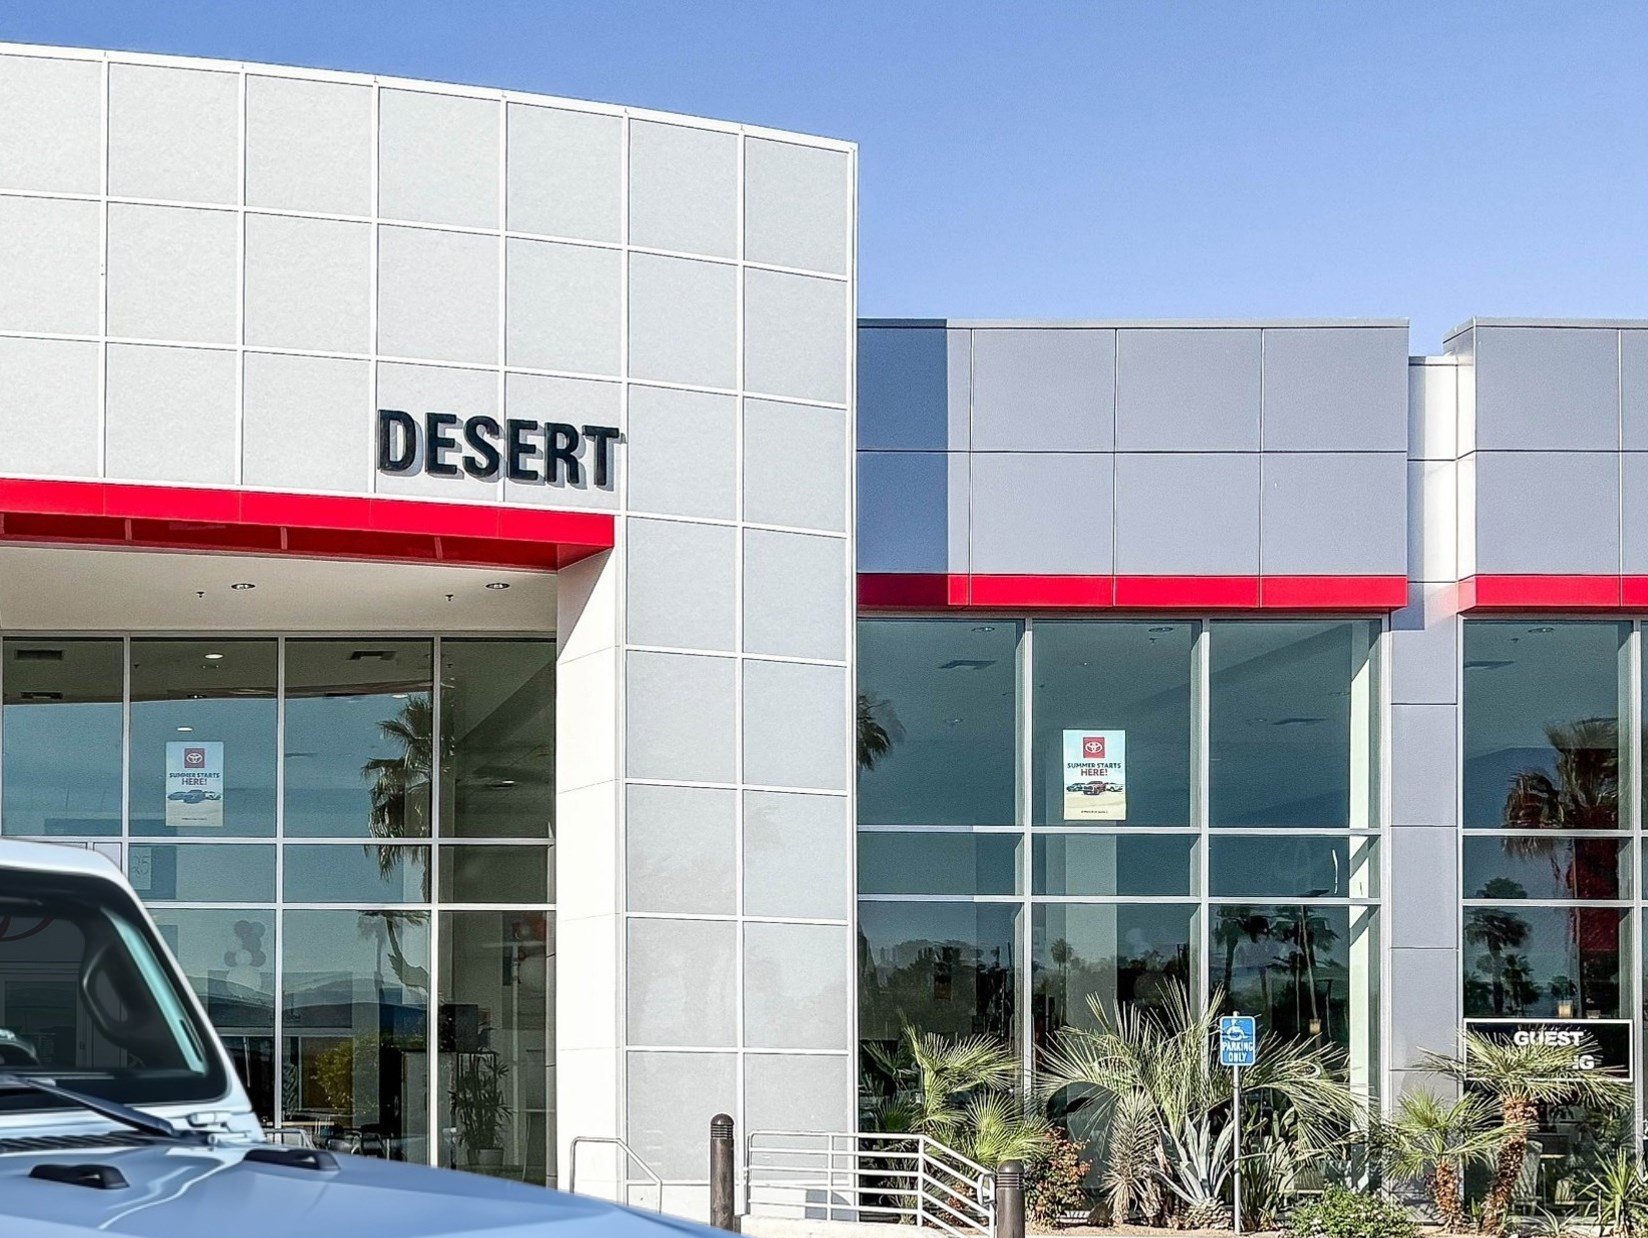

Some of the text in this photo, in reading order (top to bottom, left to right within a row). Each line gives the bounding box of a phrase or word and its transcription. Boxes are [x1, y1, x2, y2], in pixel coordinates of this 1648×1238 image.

[377, 409, 620, 486] DESERT
[1513, 1031, 1584, 1046] GUEST
[1222, 1042, 1253, 1051] PARKING
[1229, 1053, 1247, 1062] ONLY
